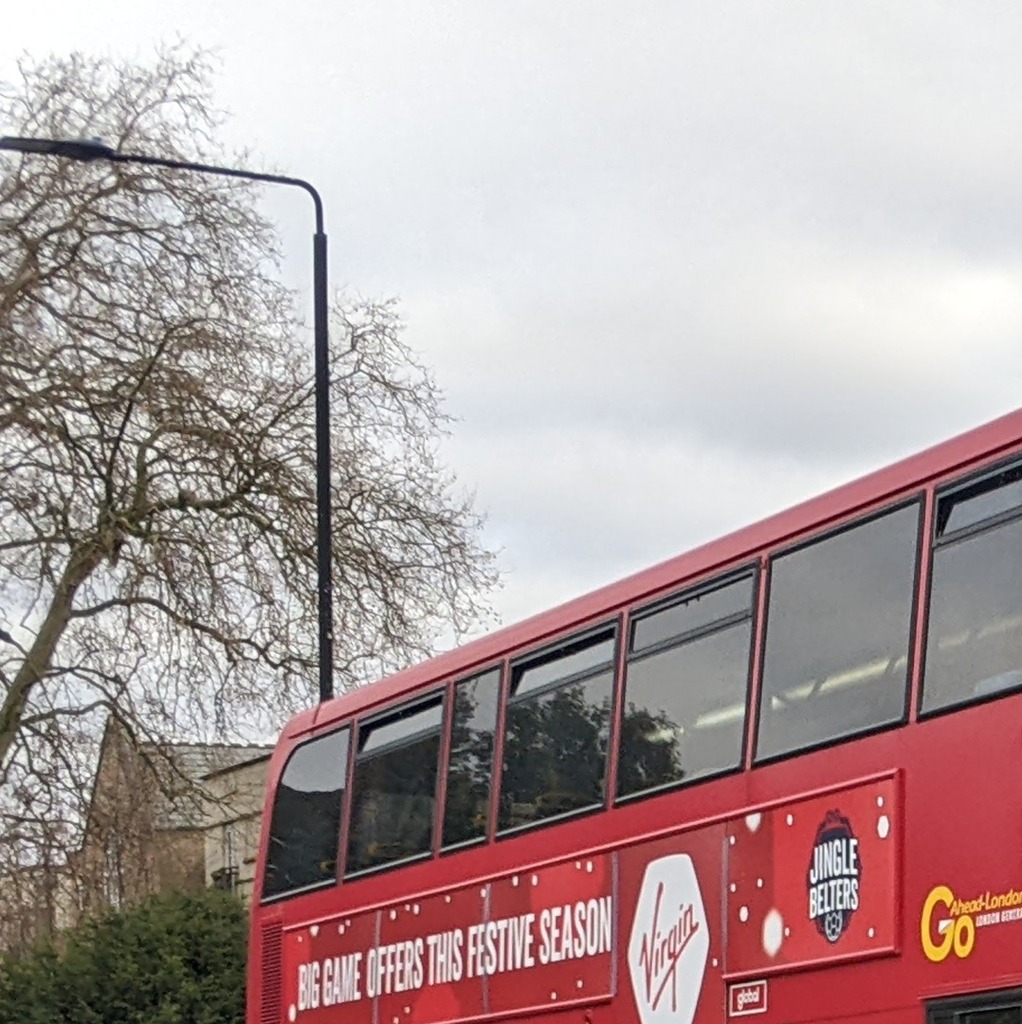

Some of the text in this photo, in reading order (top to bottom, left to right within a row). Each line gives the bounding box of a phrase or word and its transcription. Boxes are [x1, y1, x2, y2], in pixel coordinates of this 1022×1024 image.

[809, 877, 859, 919] BELTERS
[810, 838, 858, 884] JINGLE
[298, 896, 613, 1012] BIG GAME OFFERS THIS FESTIVE SEASON
[638, 881, 700, 1013] Virgin
[920, 885, 975, 962] Go
